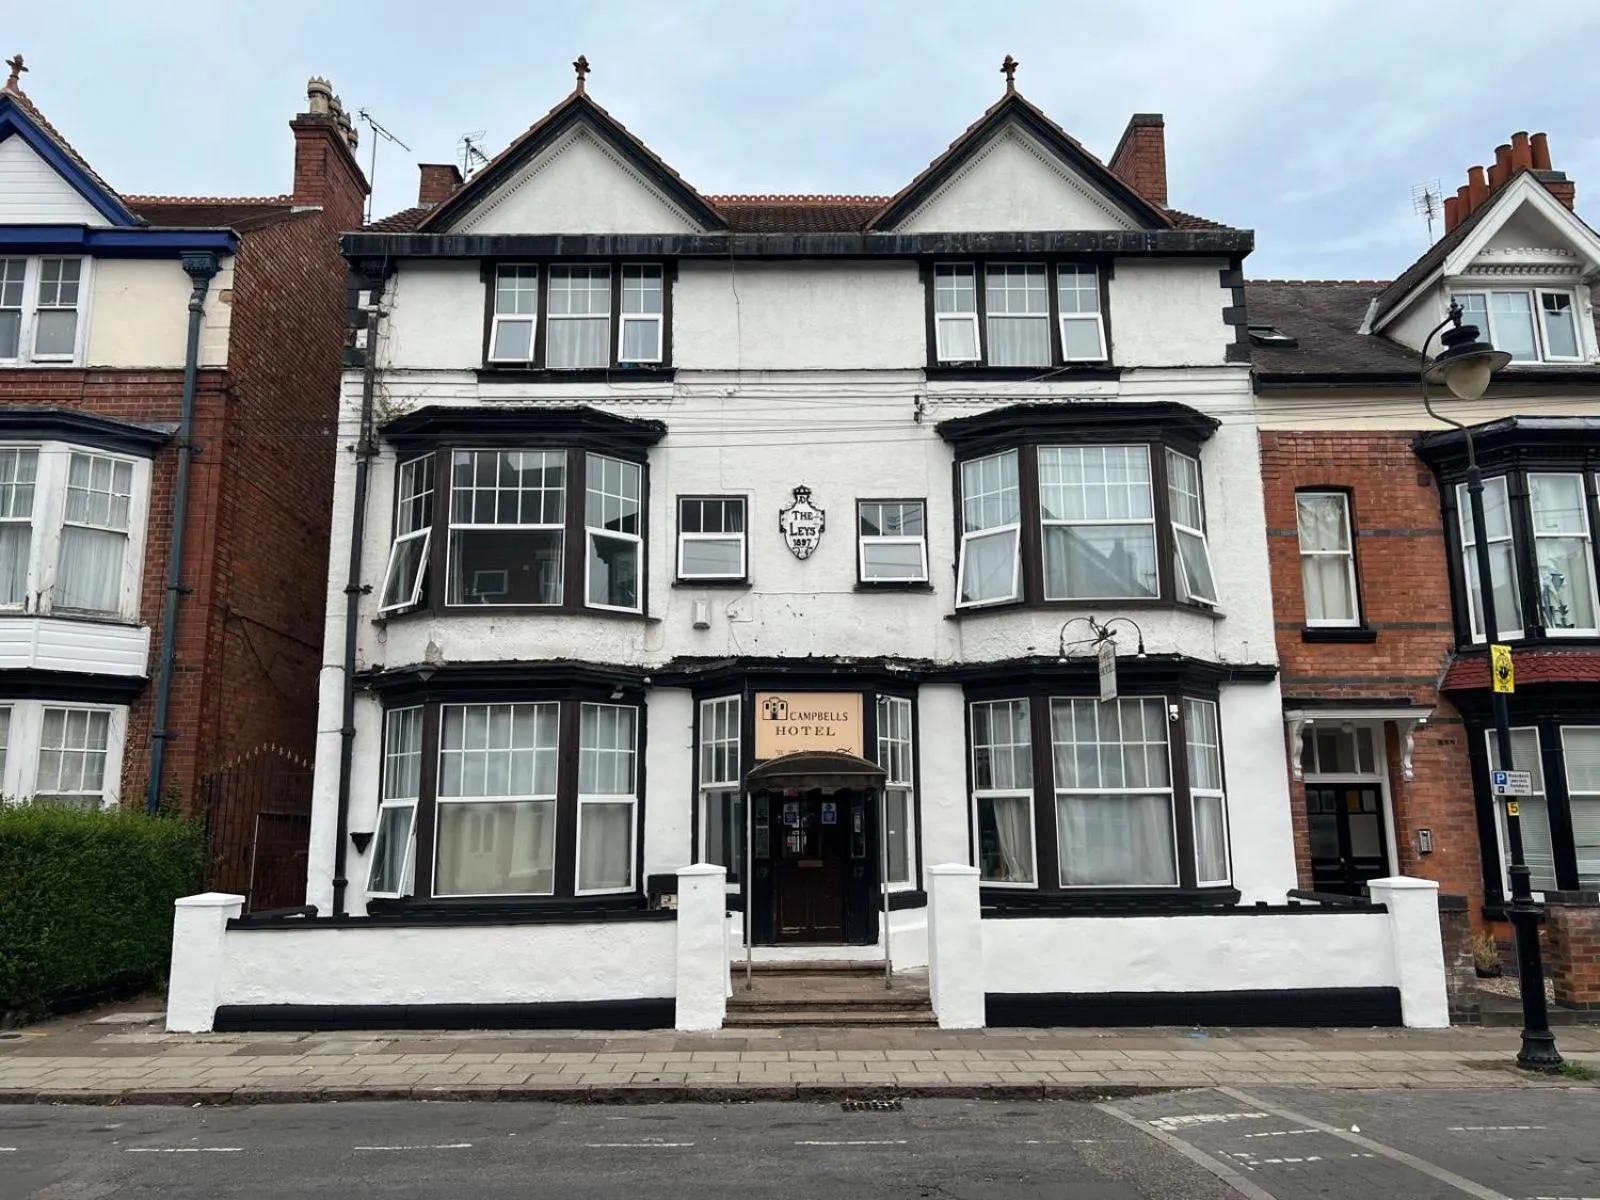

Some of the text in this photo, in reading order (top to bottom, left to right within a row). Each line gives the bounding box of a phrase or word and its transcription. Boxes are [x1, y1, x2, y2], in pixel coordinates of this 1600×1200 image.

[792, 510, 813, 520] THE
[789, 711, 849, 721] CAMPBELLS
[775, 726, 836, 736] HOTEL
[1496, 773, 1505, 784] P
[1510, 803, 1518, 813] 5
